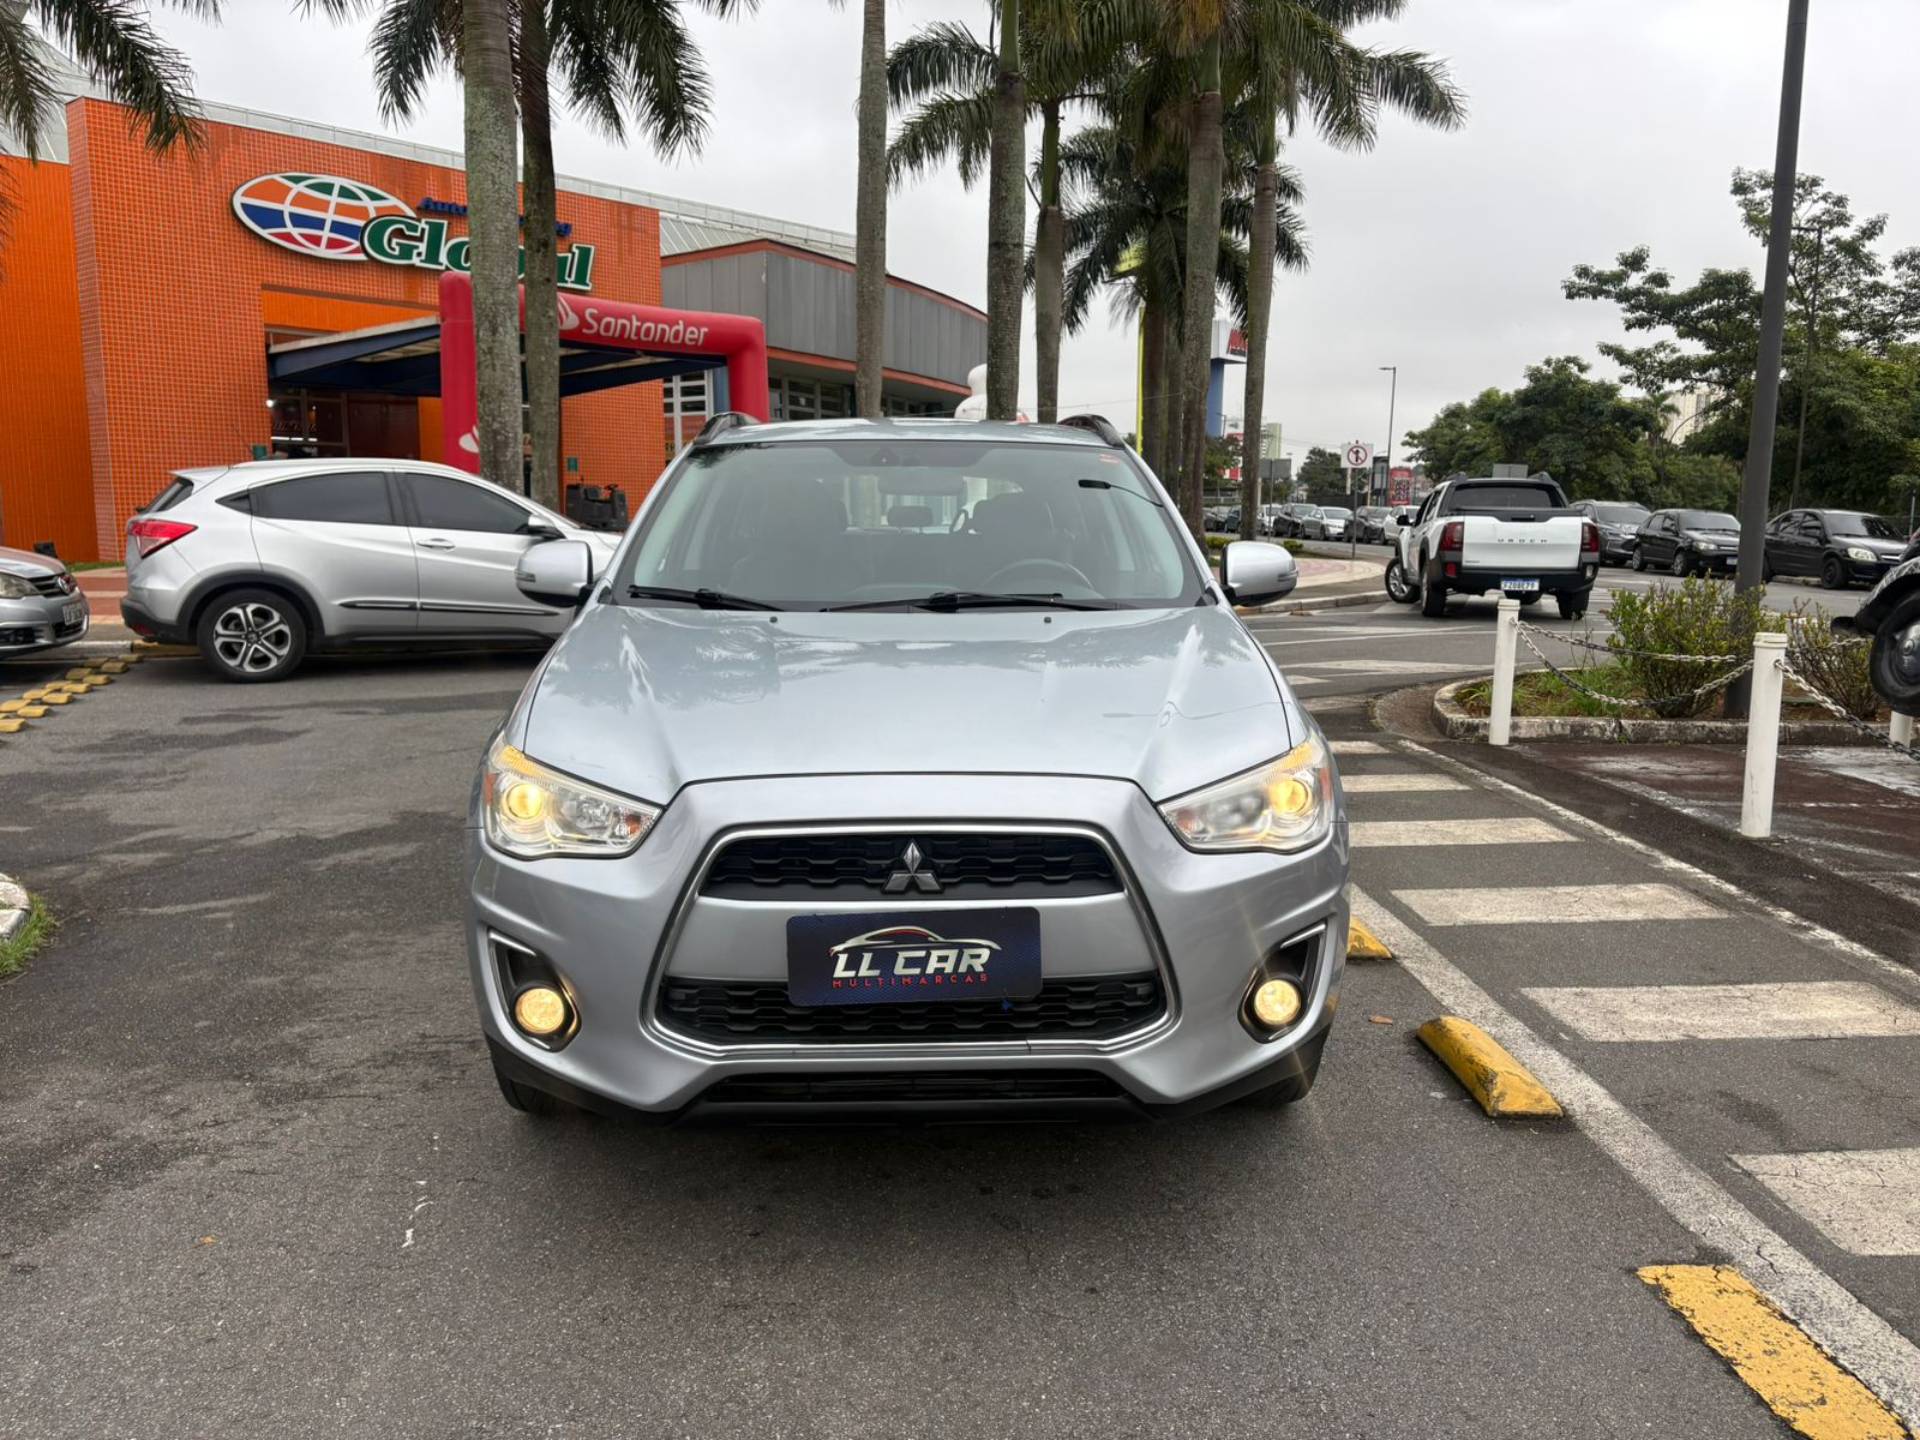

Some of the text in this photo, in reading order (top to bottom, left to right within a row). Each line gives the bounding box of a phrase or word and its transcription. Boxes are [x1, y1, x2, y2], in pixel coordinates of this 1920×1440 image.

[582, 308, 709, 346] Santander
[832, 948, 991, 978] LL CAR
[832, 974, 989, 989] MULTIMARCAS
